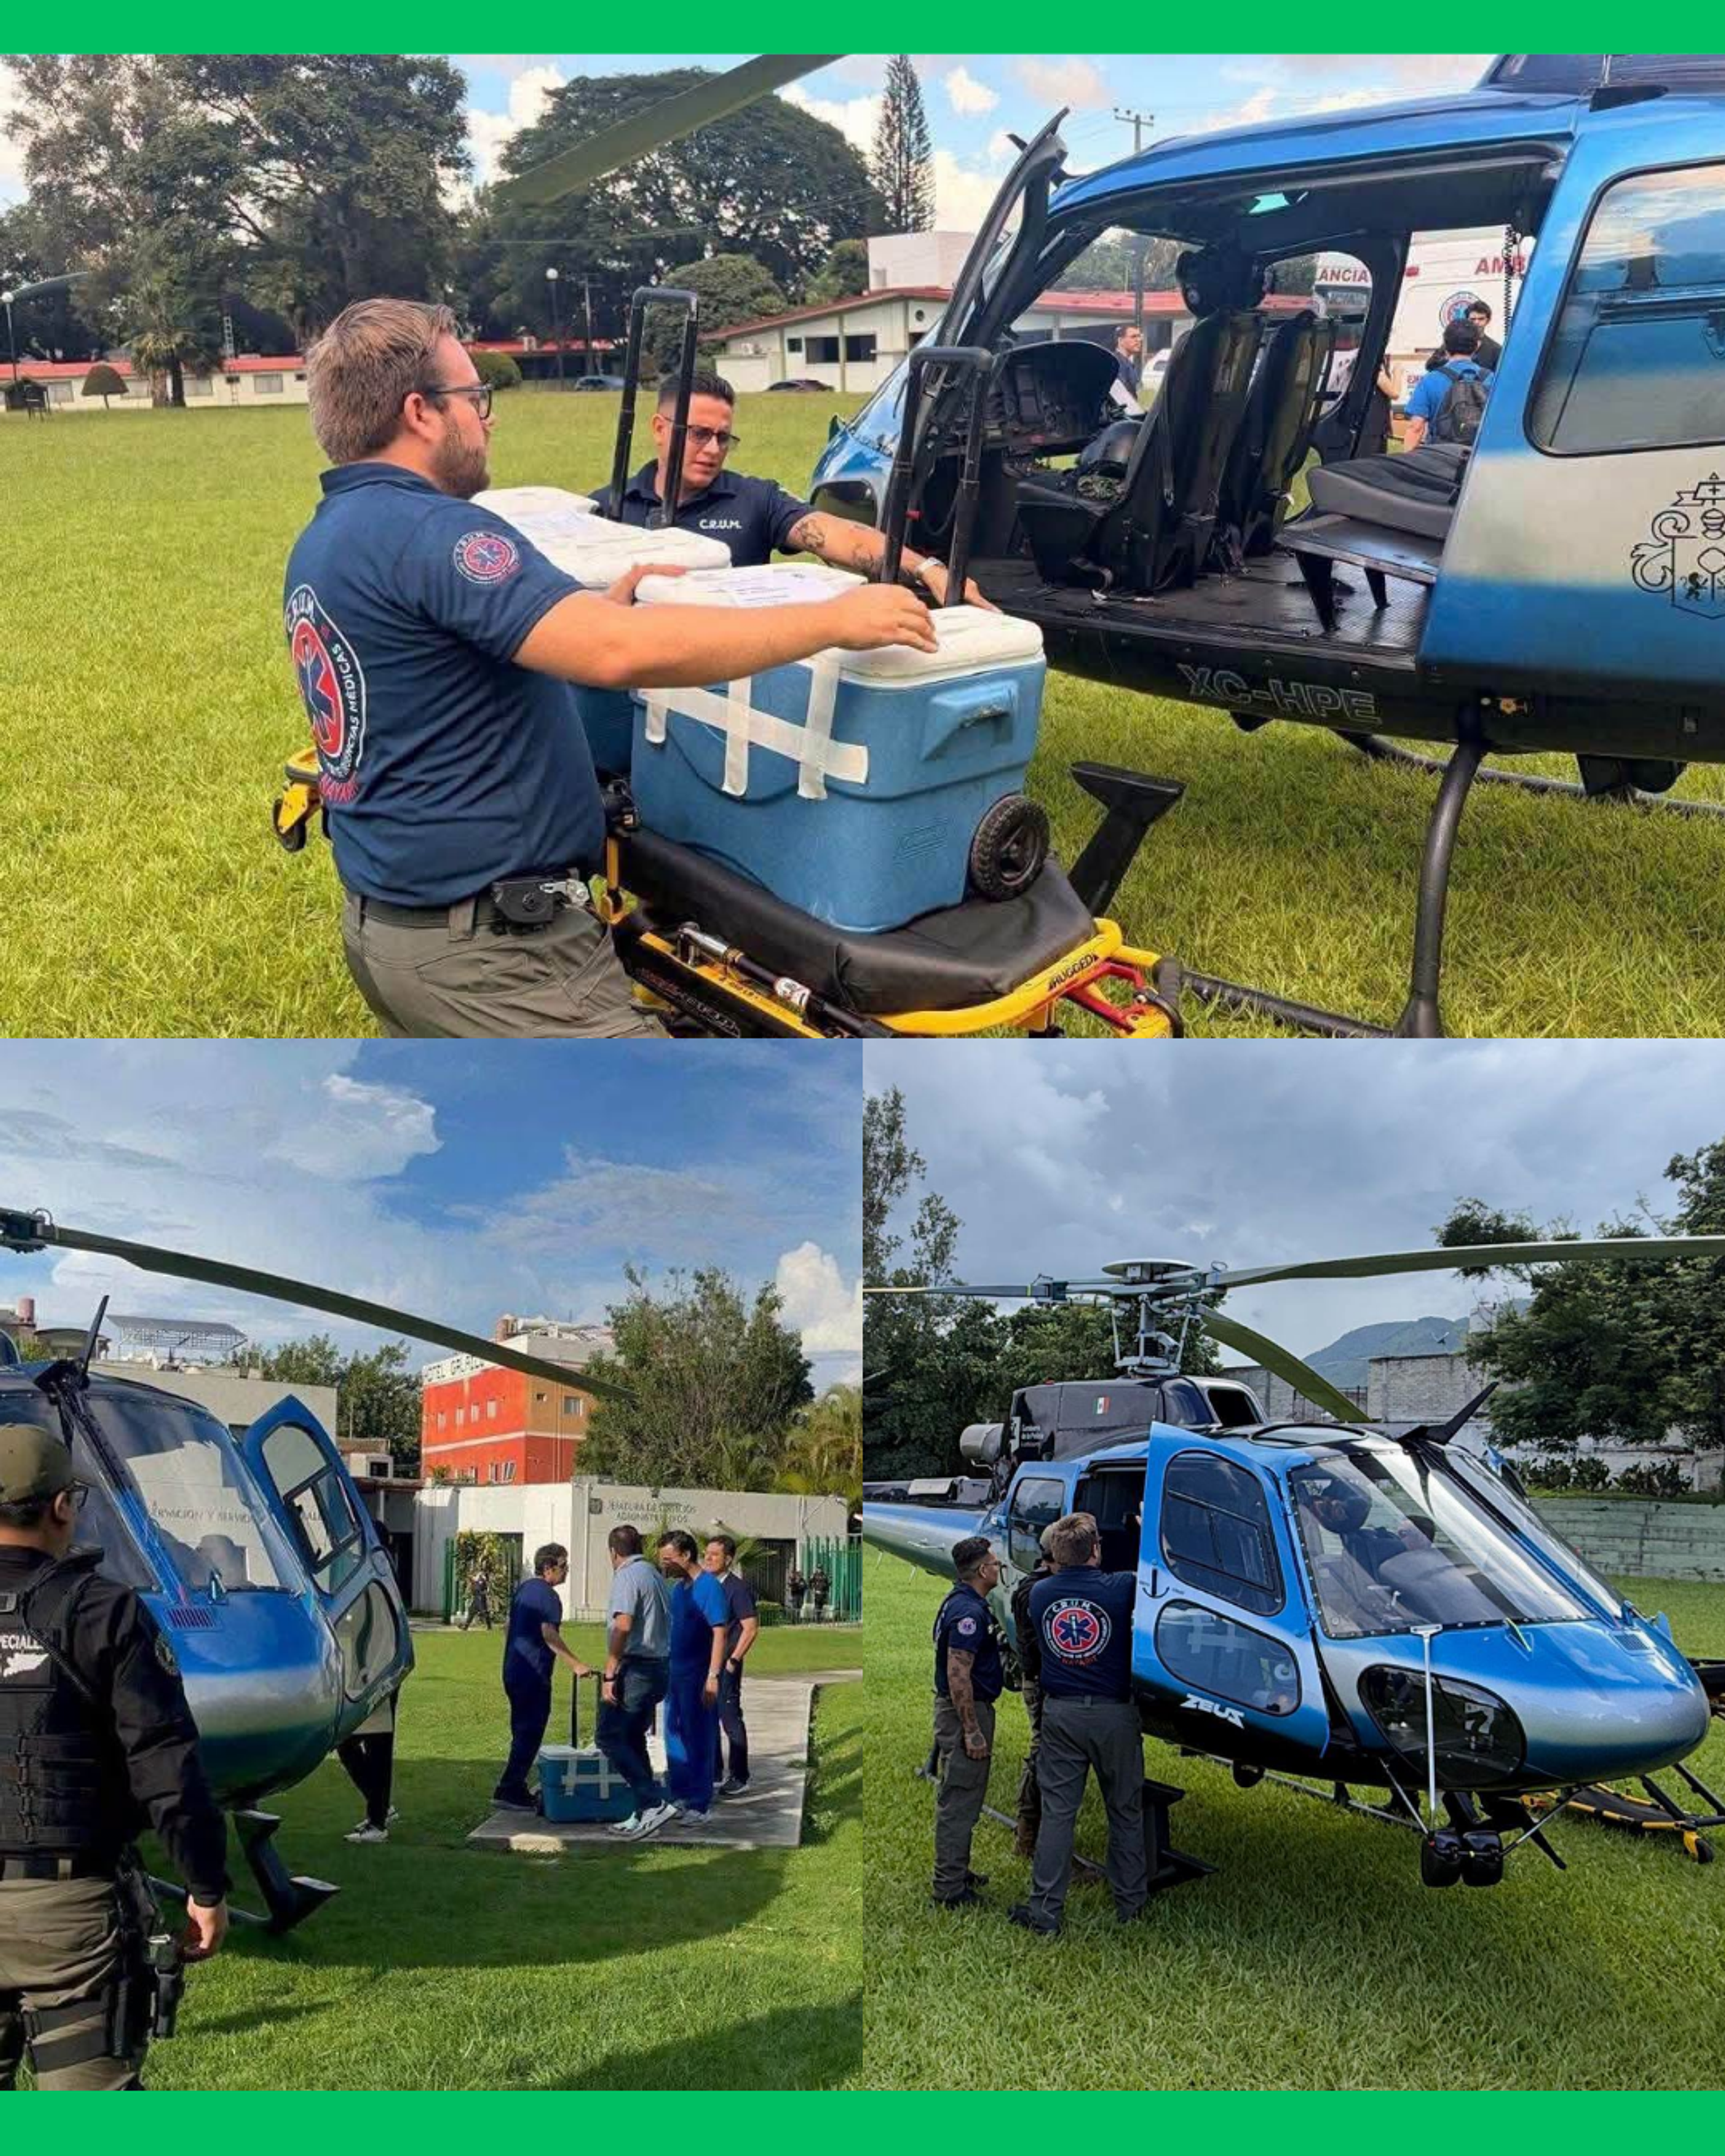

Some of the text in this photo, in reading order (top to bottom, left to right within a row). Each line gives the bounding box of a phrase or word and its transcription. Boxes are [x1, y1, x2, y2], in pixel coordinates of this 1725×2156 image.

[1319, 269, 1369, 283] ANCIA
[1177, 663, 1382, 724] XC-HPE
[1180, 1692, 1245, 1729] ZEUS
